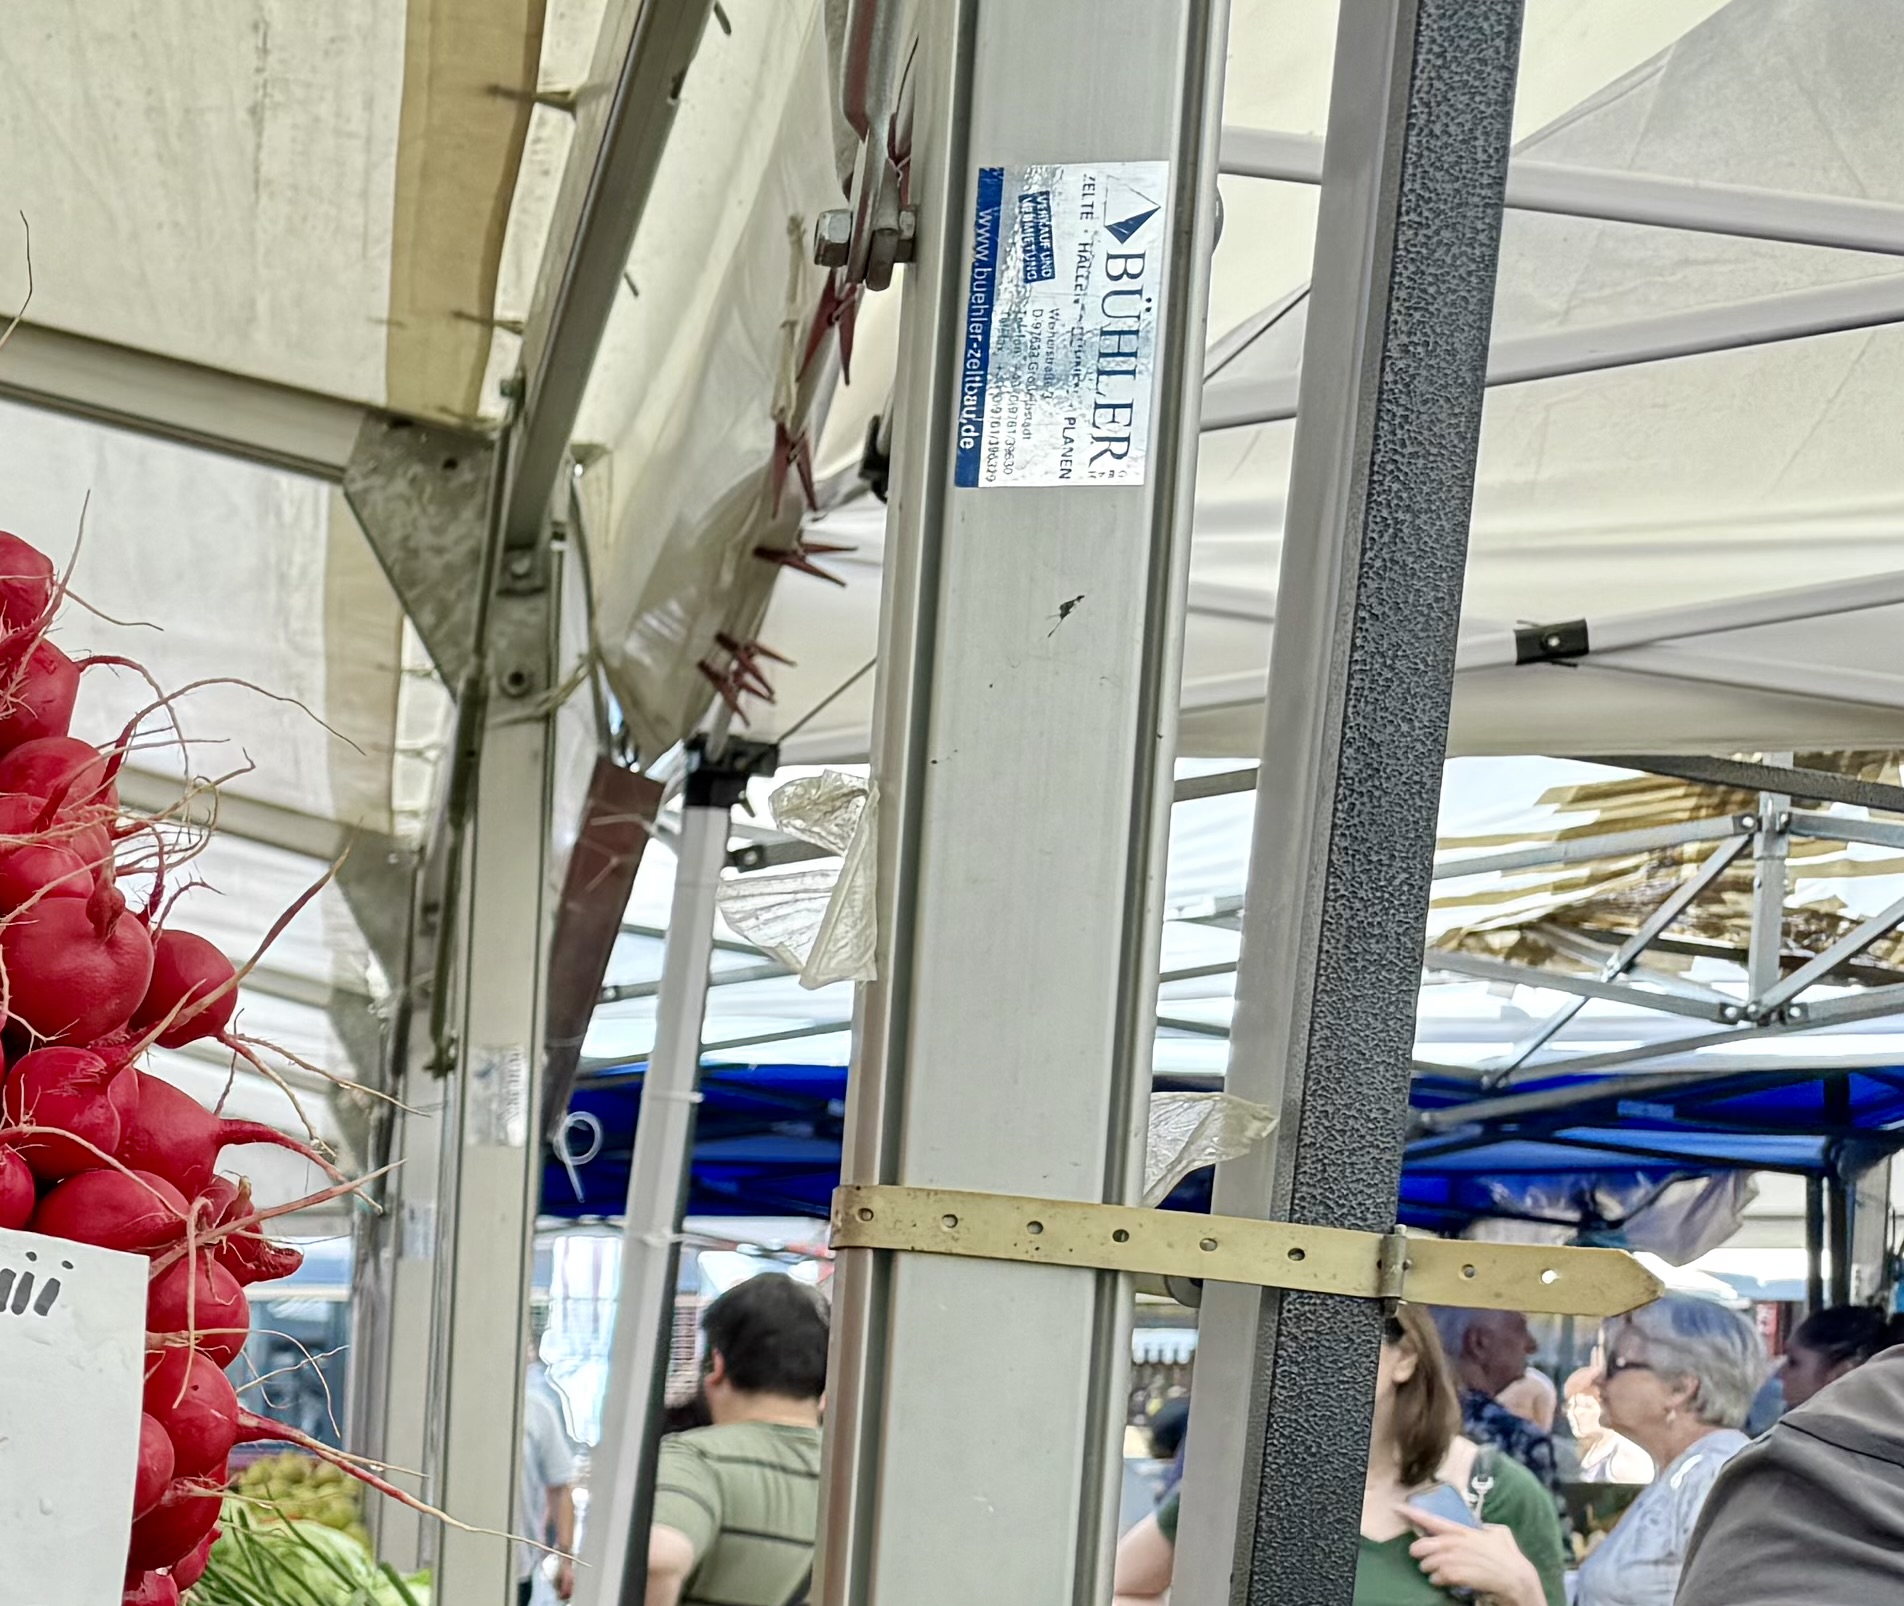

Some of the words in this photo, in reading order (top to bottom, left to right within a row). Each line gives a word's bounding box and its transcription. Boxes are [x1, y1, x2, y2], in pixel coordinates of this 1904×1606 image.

[1039, 251, 1054, 278] UND
[1088, 249, 1152, 467] BÜHLER
[1059, 415, 1077, 480] PLANEN
